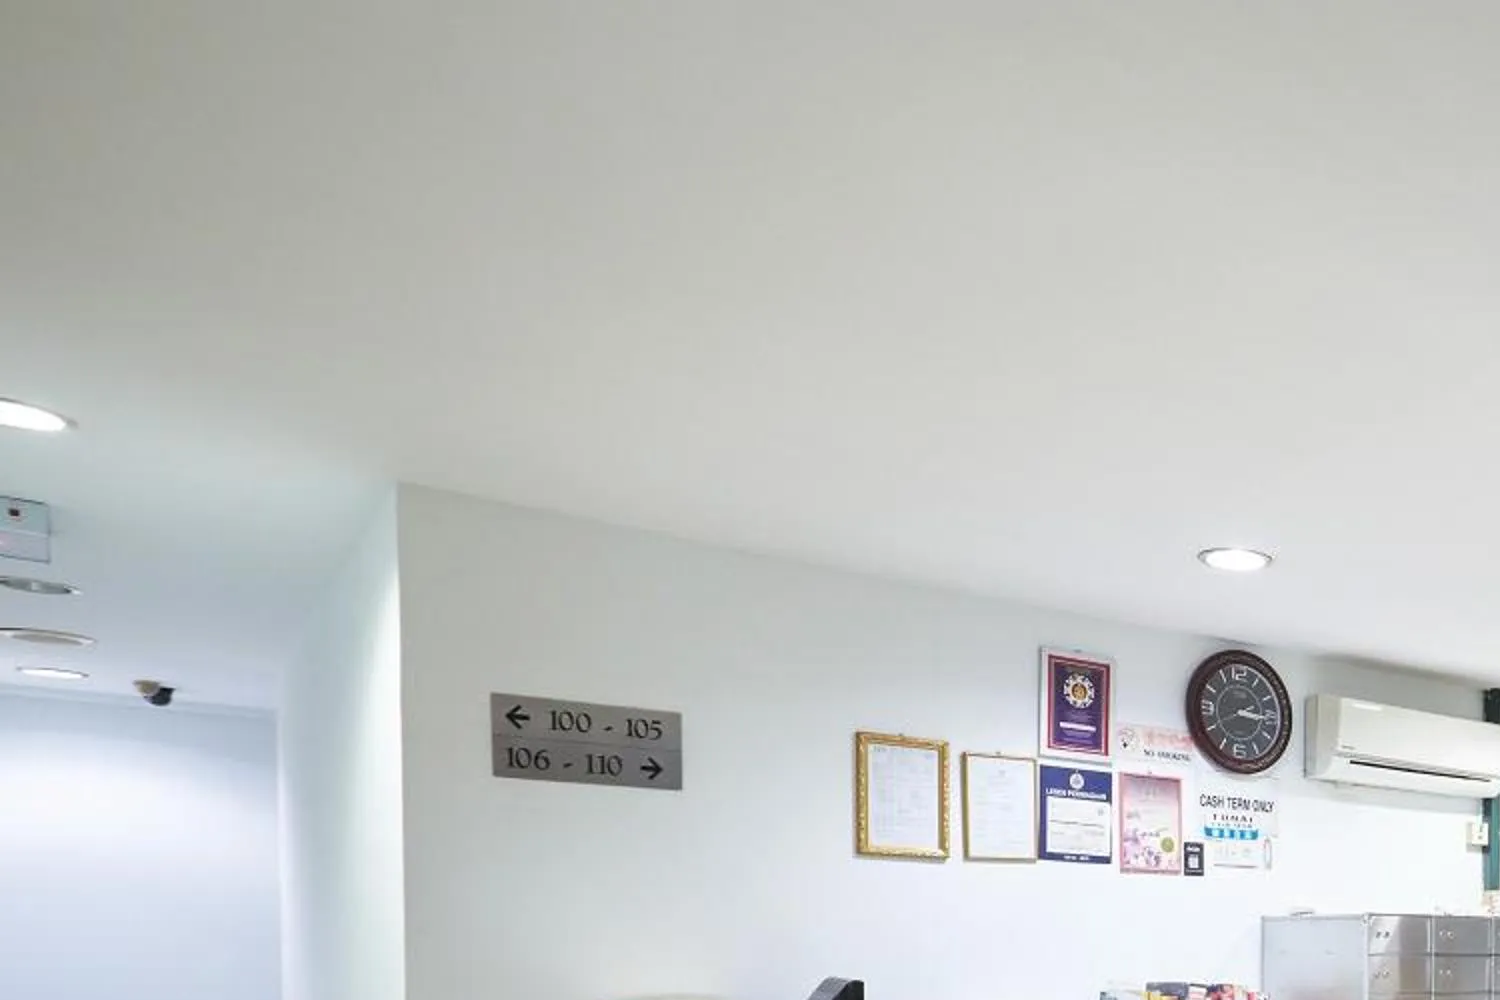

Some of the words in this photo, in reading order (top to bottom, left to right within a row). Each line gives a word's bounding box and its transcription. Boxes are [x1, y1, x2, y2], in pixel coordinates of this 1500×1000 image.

[1231, 664, 1248, 682] 12
[550, 710, 592, 732] 100
[626, 718, 664, 740] 105
[507, 747, 551, 770] 106
[585, 753, 623, 776] 110
[1200, 794, 1225, 808] CASH
[1227, 797, 1250, 811] TERM
[1252, 800, 1275, 813] ONLY
